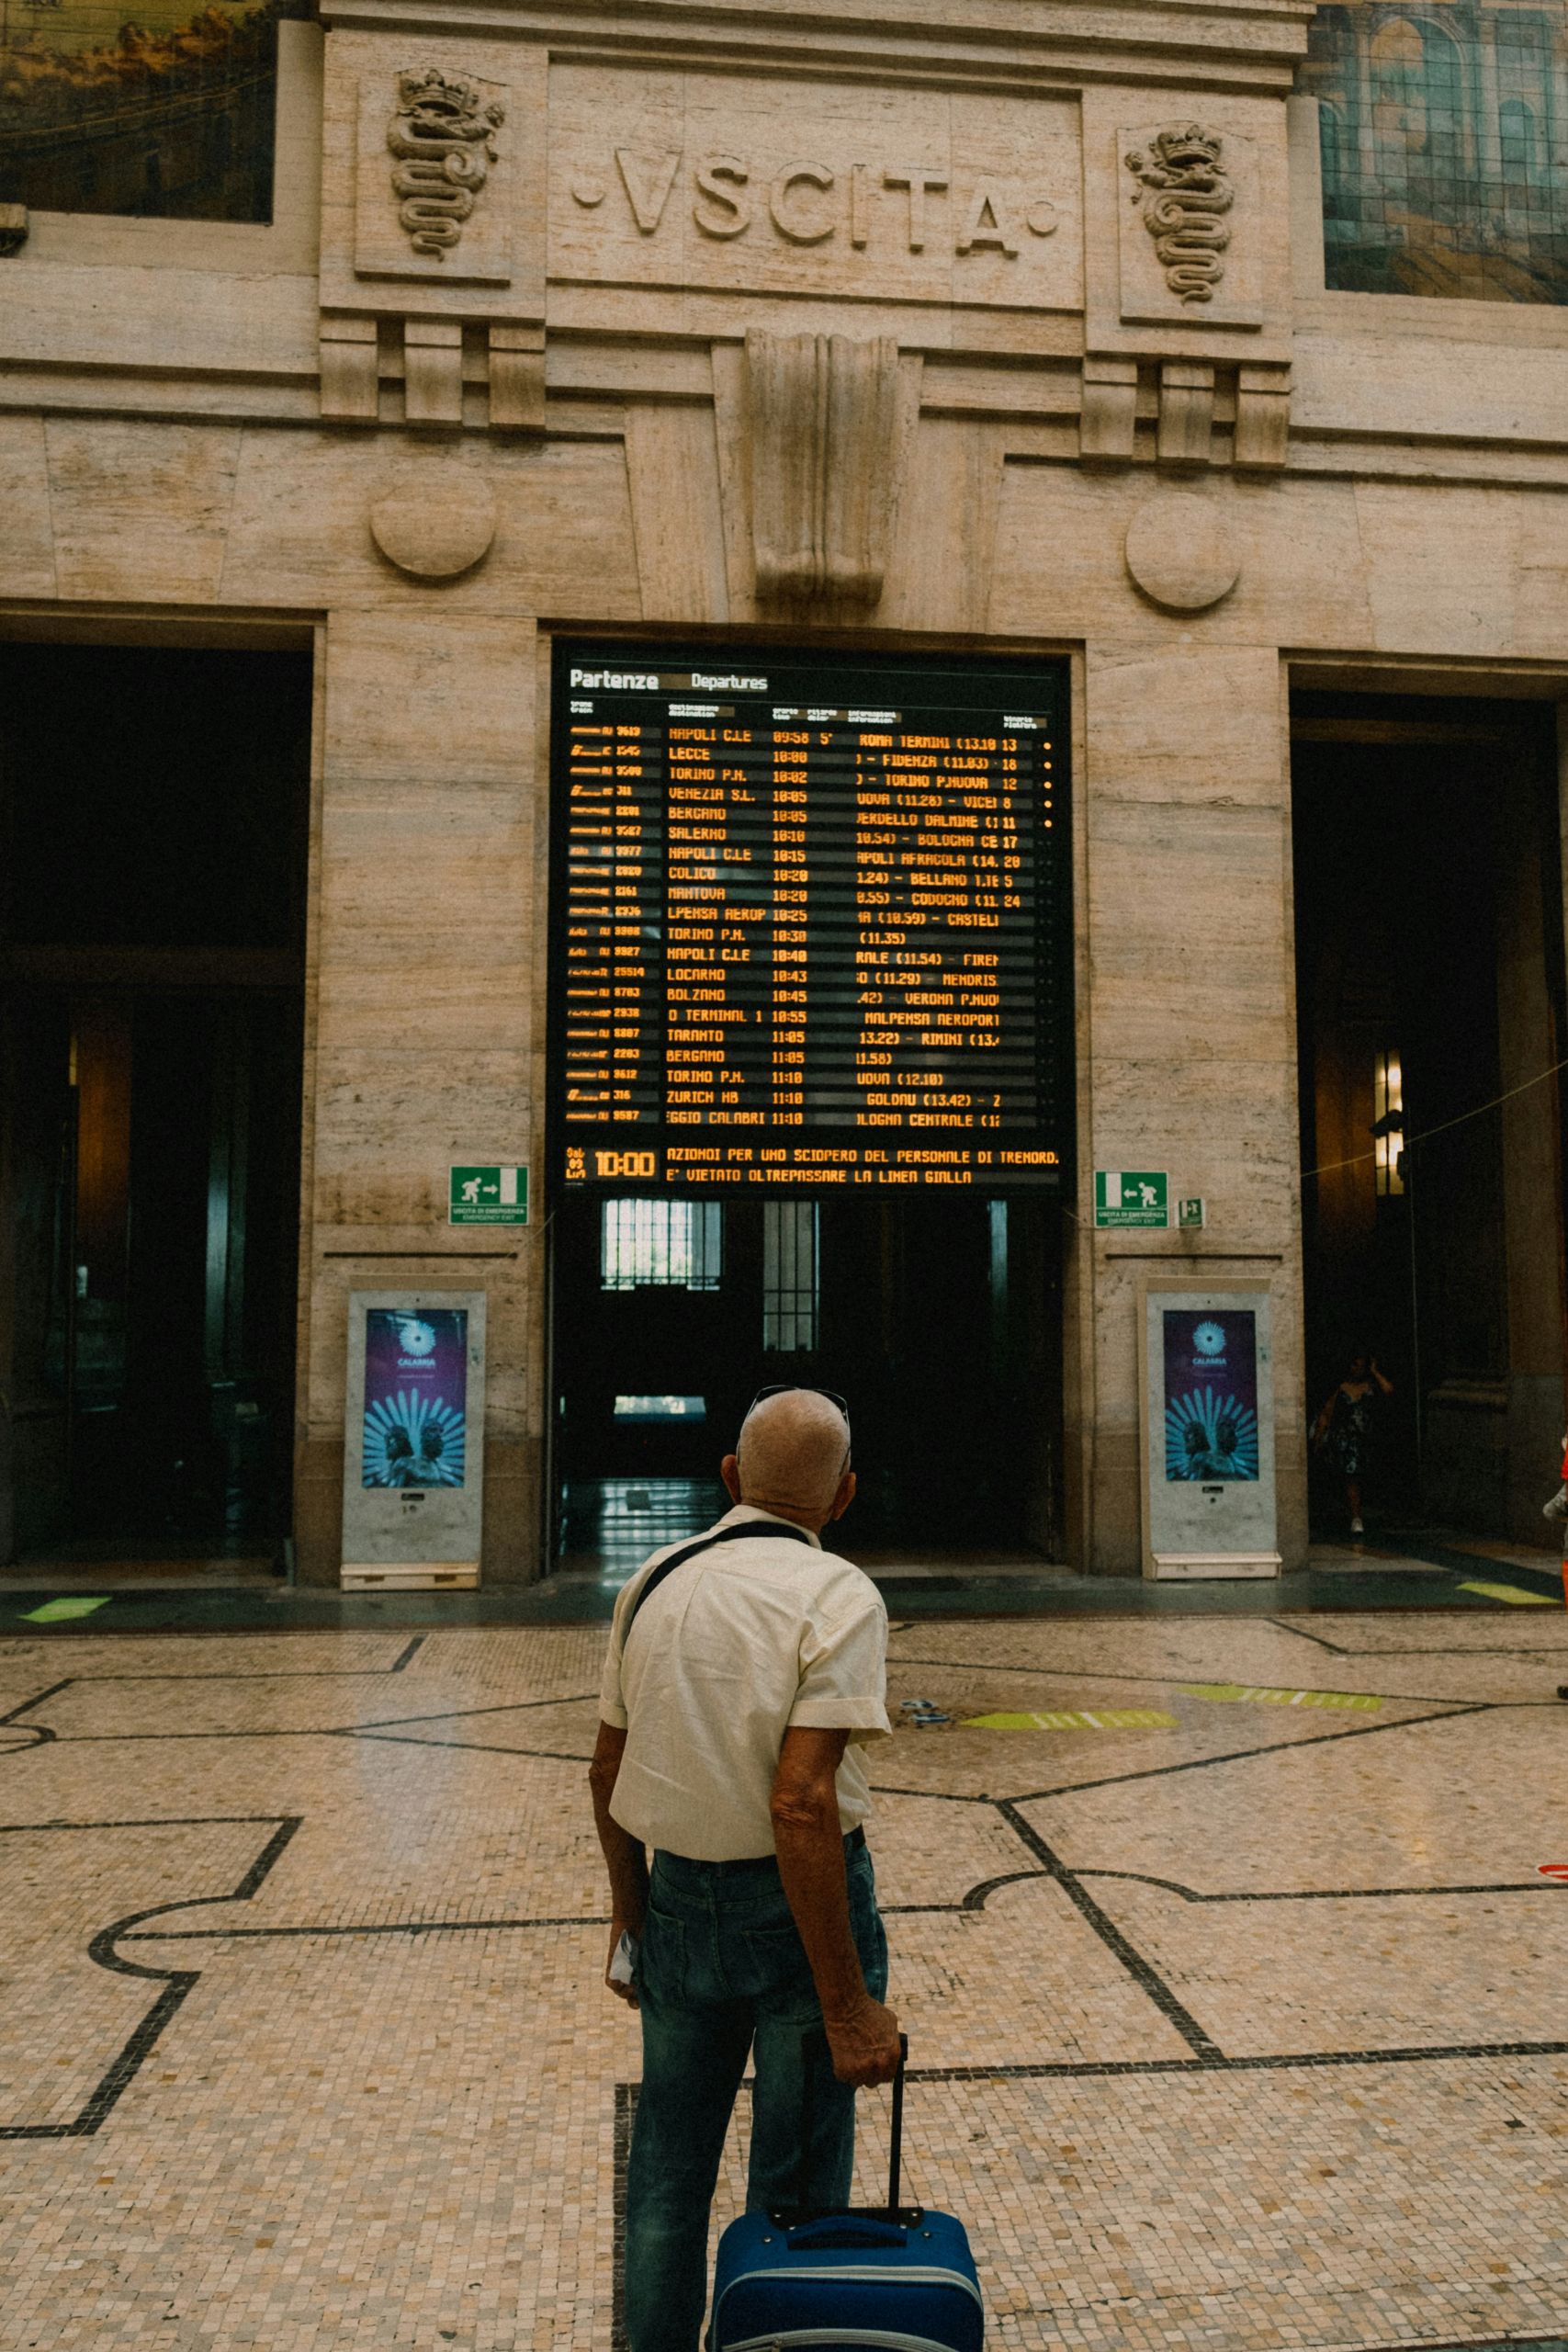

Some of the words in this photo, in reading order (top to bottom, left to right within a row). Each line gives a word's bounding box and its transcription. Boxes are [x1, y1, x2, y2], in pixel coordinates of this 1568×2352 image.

[614, 147, 1019, 260] VSCITA
[570, 669, 659, 690] Partenze
[691, 673, 768, 691] Departures
[670, 729, 716, 741] NAPOLI
[724, 729, 751, 741] C.LE
[773, 731, 809, 743] 09:58
[860, 734, 893, 746] ROMA
[901, 736, 950, 749] TERMINI
[1002, 739, 1017, 752] 13
[670, 748, 710, 760] LECCE
[773, 752, 807, 763] 10:00
[883, 754, 937, 767] FIDENZA
[671, 767, 715, 780] TORINO
[773, 771, 807, 783] 10:02
[1003, 778, 1017, 790] 12
[669, 787, 724, 800] VENEZIA
[731, 789, 755, 801] S.L.
[773, 791, 807, 802] 10:05
[669, 807, 726, 820] BERGAMO
[773, 810, 807, 822] 10:05
[1003, 817, 1016, 829] 11
[669, 827, 727, 840] SALERNO
[918, 834, 974, 846] BOLOGNA
[1003, 836, 1018, 848] 17
[669, 847, 716, 860] NAPOLI
[723, 848, 751, 861] C.LE
[773, 850, 806, 862] 10:15
[669, 867, 716, 880] COLICO
[773, 870, 808, 882] 10:20
[910, 873, 967, 886] BELLANO
[1005, 876, 1012, 888] 5
[669, 888, 726, 899] MANTOVA
[773, 890, 807, 902] 10:20
[911, 893, 968, 906] CODOGNO
[1004, 895, 1021, 907] 24
[668, 907, 717, 920] LPENSA
[725, 909, 766, 921] AEROP
[773, 910, 807, 922] 10:25
[669, 928, 714, 940] TORINO
[773, 930, 807, 942] 10:30
[668, 948, 715, 960] NAPOLI
[722, 949, 750, 961] C.LE
[773, 950, 807, 962] 10:40
[856, 952, 888, 964] RALE
[668, 968, 725, 980] LOCARNO
[773, 970, 807, 982] 10:43
[875, 972, 920, 985] (11.29)
[668, 989, 725, 1001] BOLZANO
[773, 990, 807, 1002] 10:45
[905, 993, 953, 1005] VERONA
[686, 1010, 746, 1022] TERMINAL
[757, 1011, 761, 1022] 1
[773, 1011, 807, 1023] 10:55
[865, 1012, 931, 1024] MALPENSA
[668, 1029, 724, 1042] TARANTO
[773, 1031, 805, 1043] 11:05
[921, 1033, 962, 1046] RIMINI
[667, 1050, 725, 1062] BERGAMO
[773, 1052, 805, 1063] 11:05
[667, 1070, 713, 1082] TORINO
[773, 1072, 802, 1083] 11:10
[857, 1073, 890, 1084] UOVA
[667, 1091, 714, 1102] ZURICH
[722, 1091, 739, 1103] HB
[773, 1092, 803, 1103] 11:10
[867, 1093, 917, 1106] GOLDAU
[709, 1112, 764, 1125] CALABRI
[773, 1113, 803, 1125] 11:10
[909, 1114, 973, 1126] CENTRALE
[594, 1151, 655, 1176] 10:00
[728, 1148, 752, 1160] PER
[761, 1149, 786, 1161] UNO
[794, 1149, 857, 1161] SCIOPERO
[865, 1150, 888, 1162] DEL
[897, 1150, 969, 1163] PERSONALE
[978, 1151, 991, 1163] DI
[1000, 1151, 1058, 1163] TRENORD.
[687, 1170, 740, 1181] VIETATO
[749, 1170, 846, 1182] OLTREPASSARE
[854, 1170, 872, 1182] LA
[879, 1170, 918, 1182] LINEA
[925, 1171, 971, 1183] GIALLA
